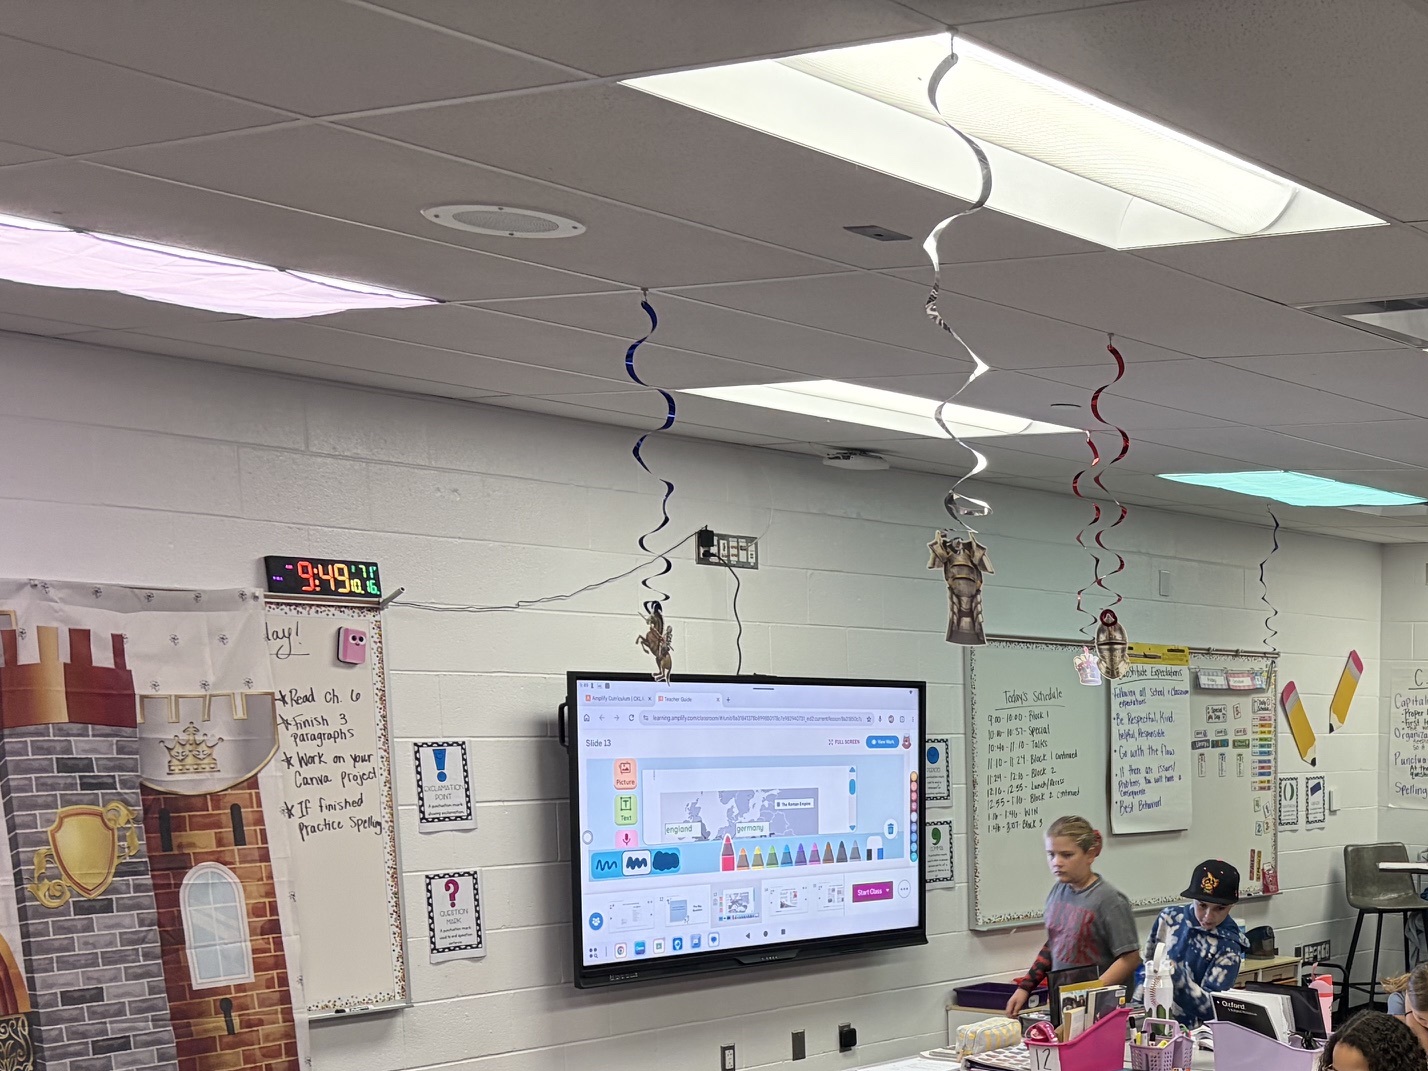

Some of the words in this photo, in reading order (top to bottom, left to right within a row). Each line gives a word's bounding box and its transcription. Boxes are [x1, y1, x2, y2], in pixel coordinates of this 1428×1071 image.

[297, 561, 351, 594] 9:49
[289, 687, 316, 708] Read
[350, 689, 362, 702] 6
[1003, 689, 1028, 705] Today's
[1032, 686, 1063, 702] Schedule
[339, 712, 348, 726] 3
[1116, 712, 1124, 726] Be
[586, 738, 602, 747] Slide
[604, 739, 612, 747] 13
[1118, 745, 1128, 760] Go
[1130, 744, 1144, 758] with
[1147, 744, 1158, 756] the
[297, 752, 328, 768] Work
[333, 756, 346, 764] on
[350, 753, 374, 769] your
[294, 770, 332, 788] Canva
[1394, 782, 1428, 800] Spelling
[298, 799, 312, 819] If
[319, 792, 364, 814] finished
[1120, 800, 1134, 816] Best
[349, 814, 383, 836] Spelling
[666, 825, 693, 835] england
[736, 824, 764, 834] germany
[857, 888, 870, 896] Start
[870, 886, 883, 896] Class
[1222, 1000, 1246, 1010] Oxford
[1036, 1048, 1052, 1070] 12
